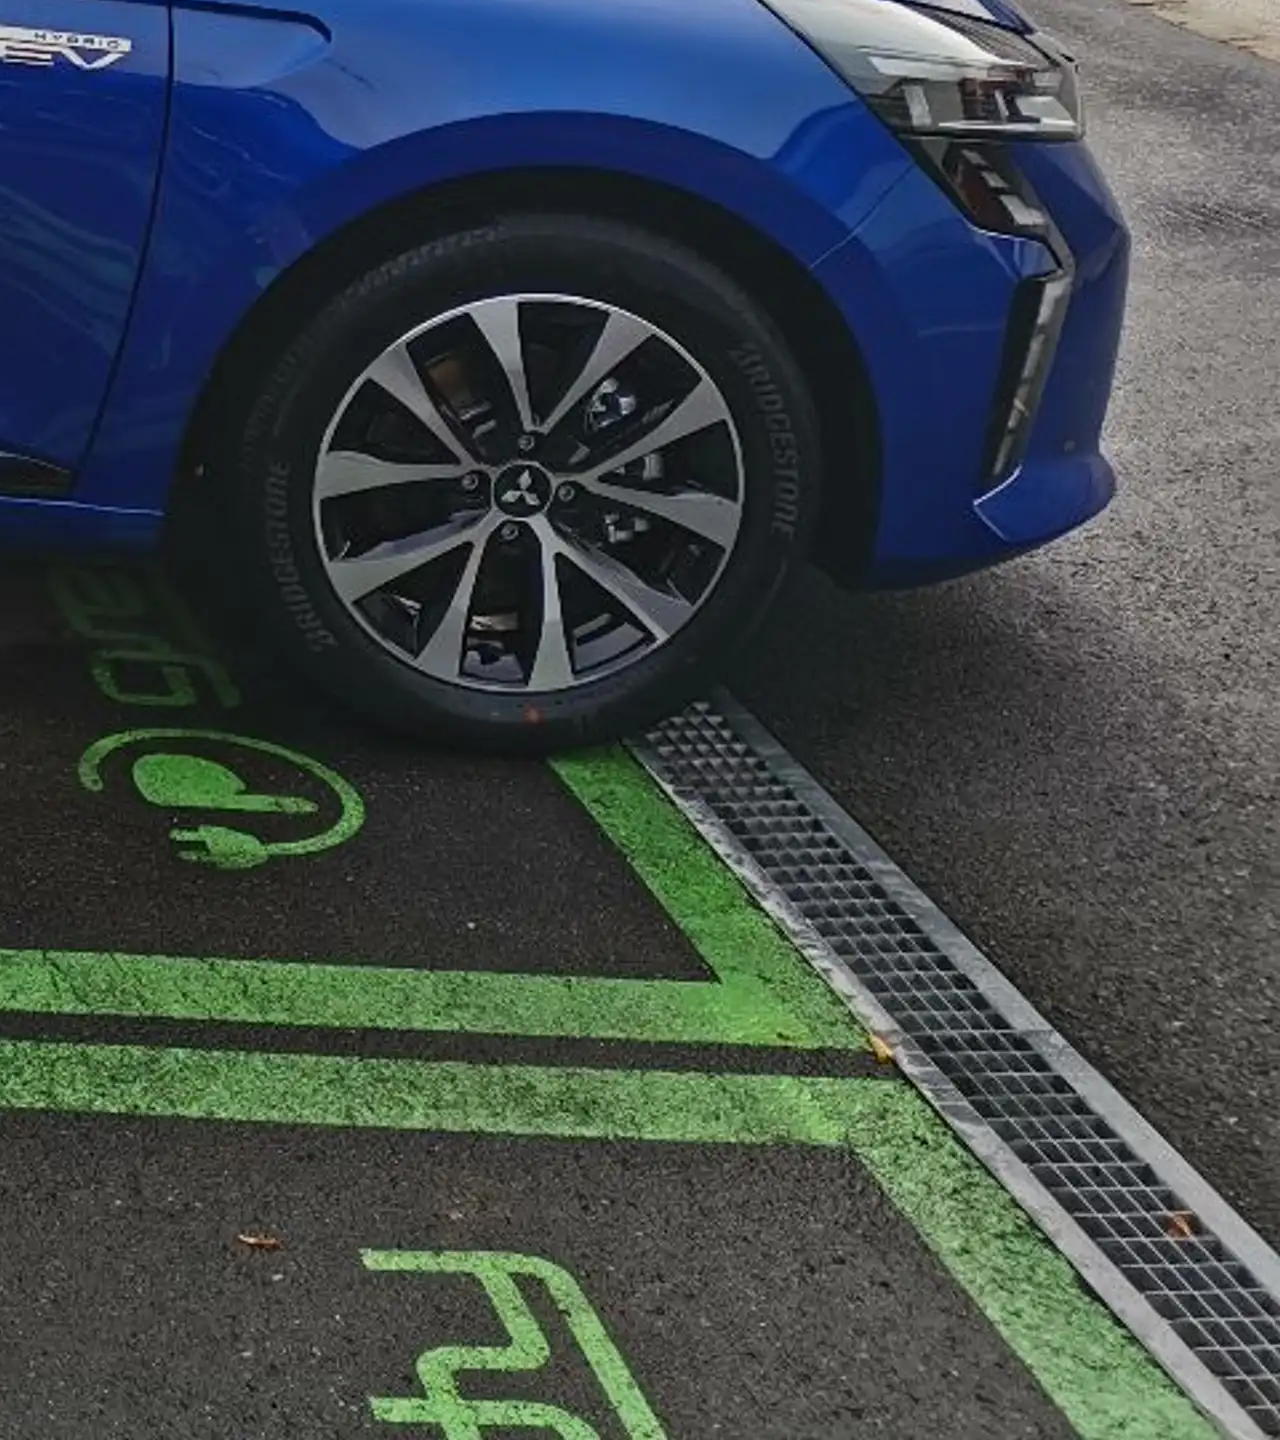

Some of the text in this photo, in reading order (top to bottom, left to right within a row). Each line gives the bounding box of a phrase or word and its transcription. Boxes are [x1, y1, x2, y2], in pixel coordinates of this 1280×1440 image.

[33, 30, 122, 51] HYBRID
[729, 340, 801, 540] BRIDGESTONE
[262, 460, 339, 653] BRIDGESTONE
